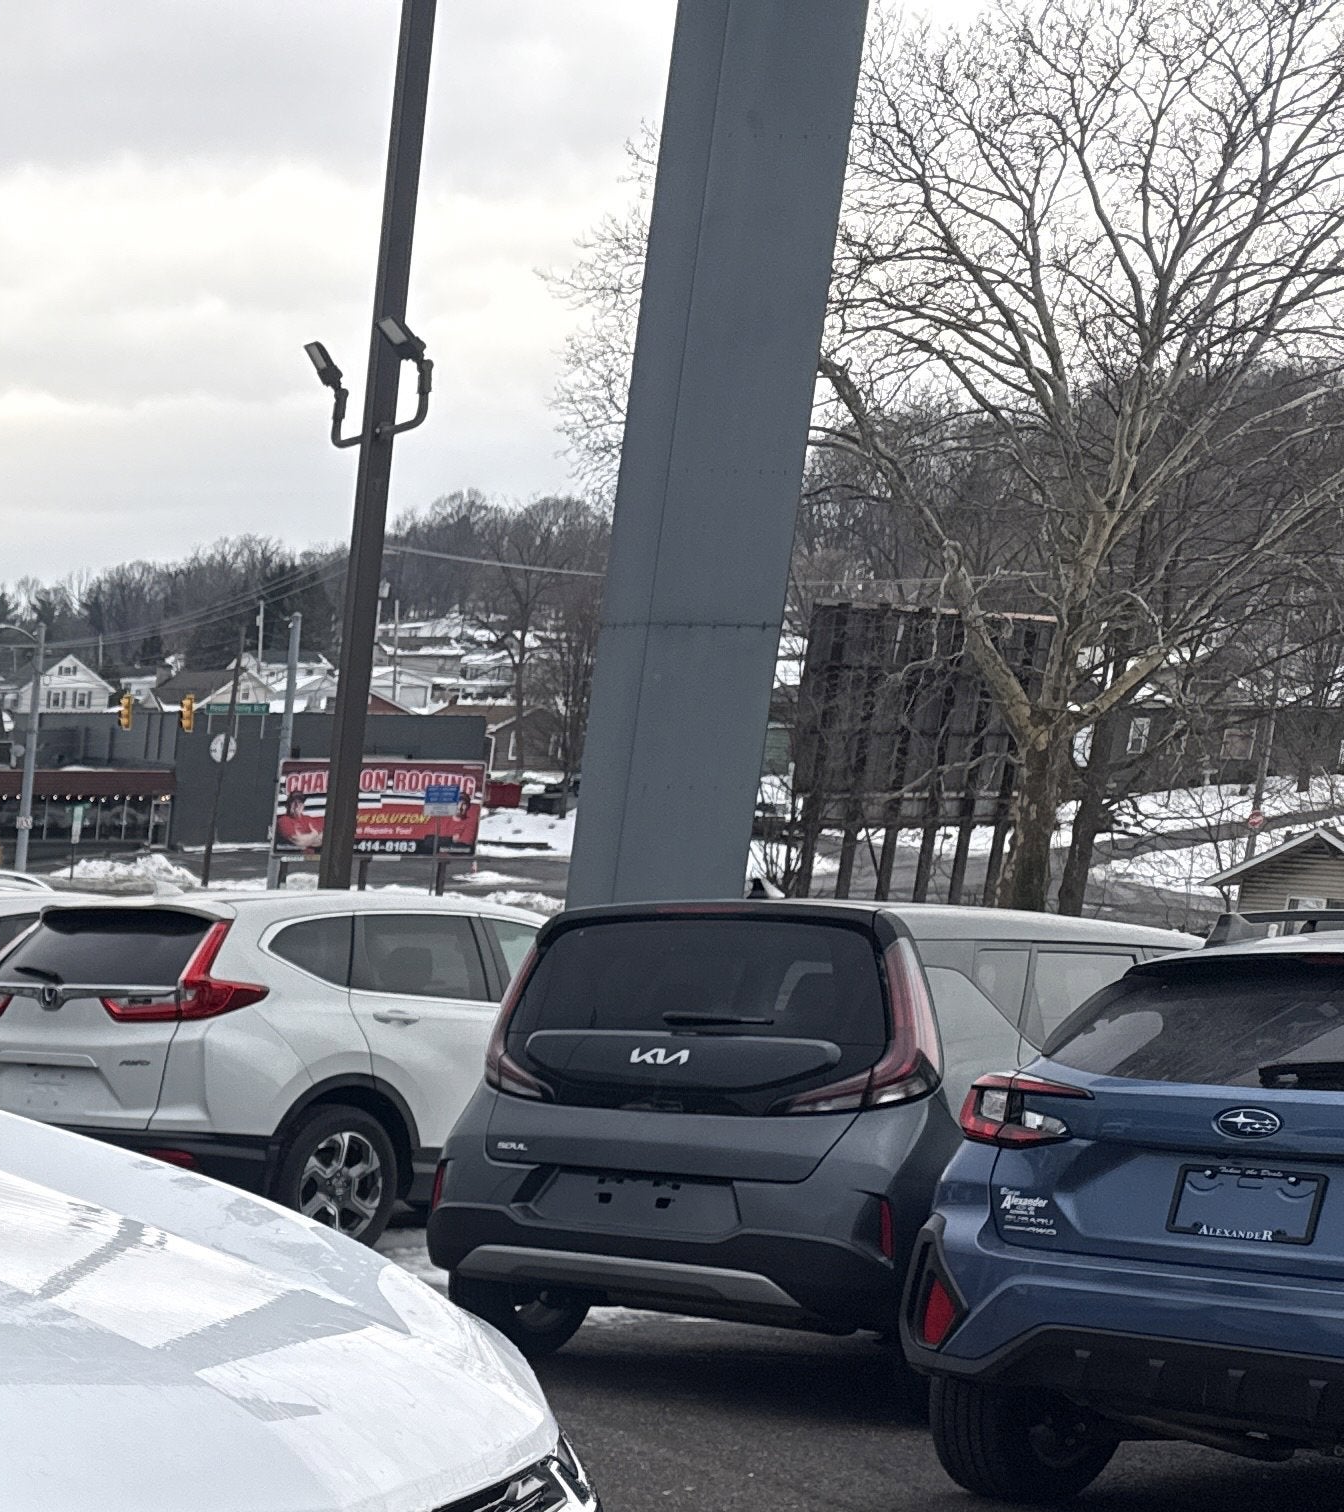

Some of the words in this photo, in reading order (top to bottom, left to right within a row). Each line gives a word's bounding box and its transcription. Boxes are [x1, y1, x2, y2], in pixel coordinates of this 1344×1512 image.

[286, 769, 388, 796] CHAON
[497, 1141, 528, 1151] SOUL
[1000, 1194, 1048, 1210] Alexander
[1198, 1224, 1273, 1242] ALEXANDER
